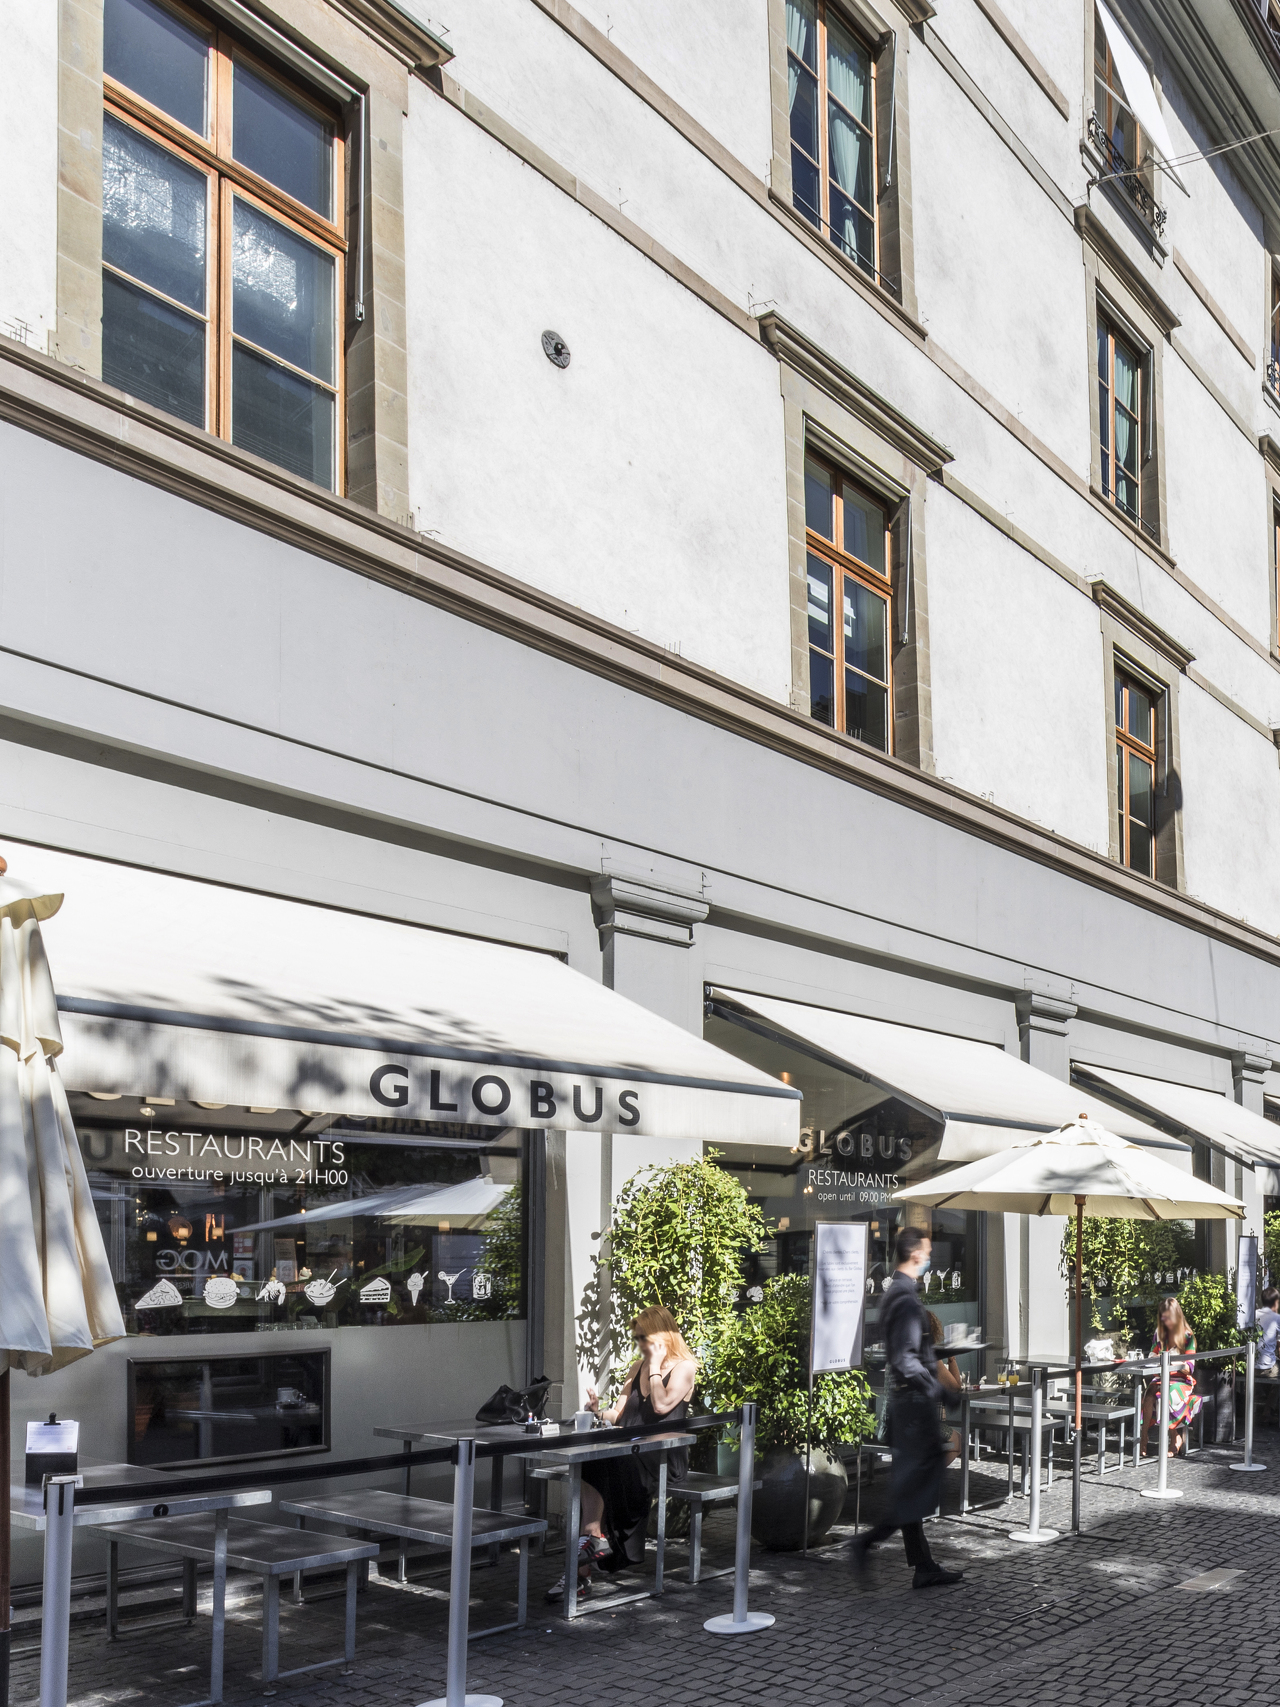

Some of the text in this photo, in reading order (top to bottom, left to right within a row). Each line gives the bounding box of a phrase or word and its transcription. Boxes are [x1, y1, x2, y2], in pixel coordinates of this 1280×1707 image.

[369, 1064, 641, 1127] GLOBUS
[124, 1128, 345, 1164] RESTAURANTS
[799, 1127, 912, 1160] GLOBUS
[131, 1165, 224, 1182] ouverture
[295, 1168, 349, 1186] 21H00
[808, 1169, 899, 1189] RESTAURANTS
[817, 1191, 837, 1203] open
[839, 1191, 856, 1201] until
[859, 1191, 879, 1203] 09.00
